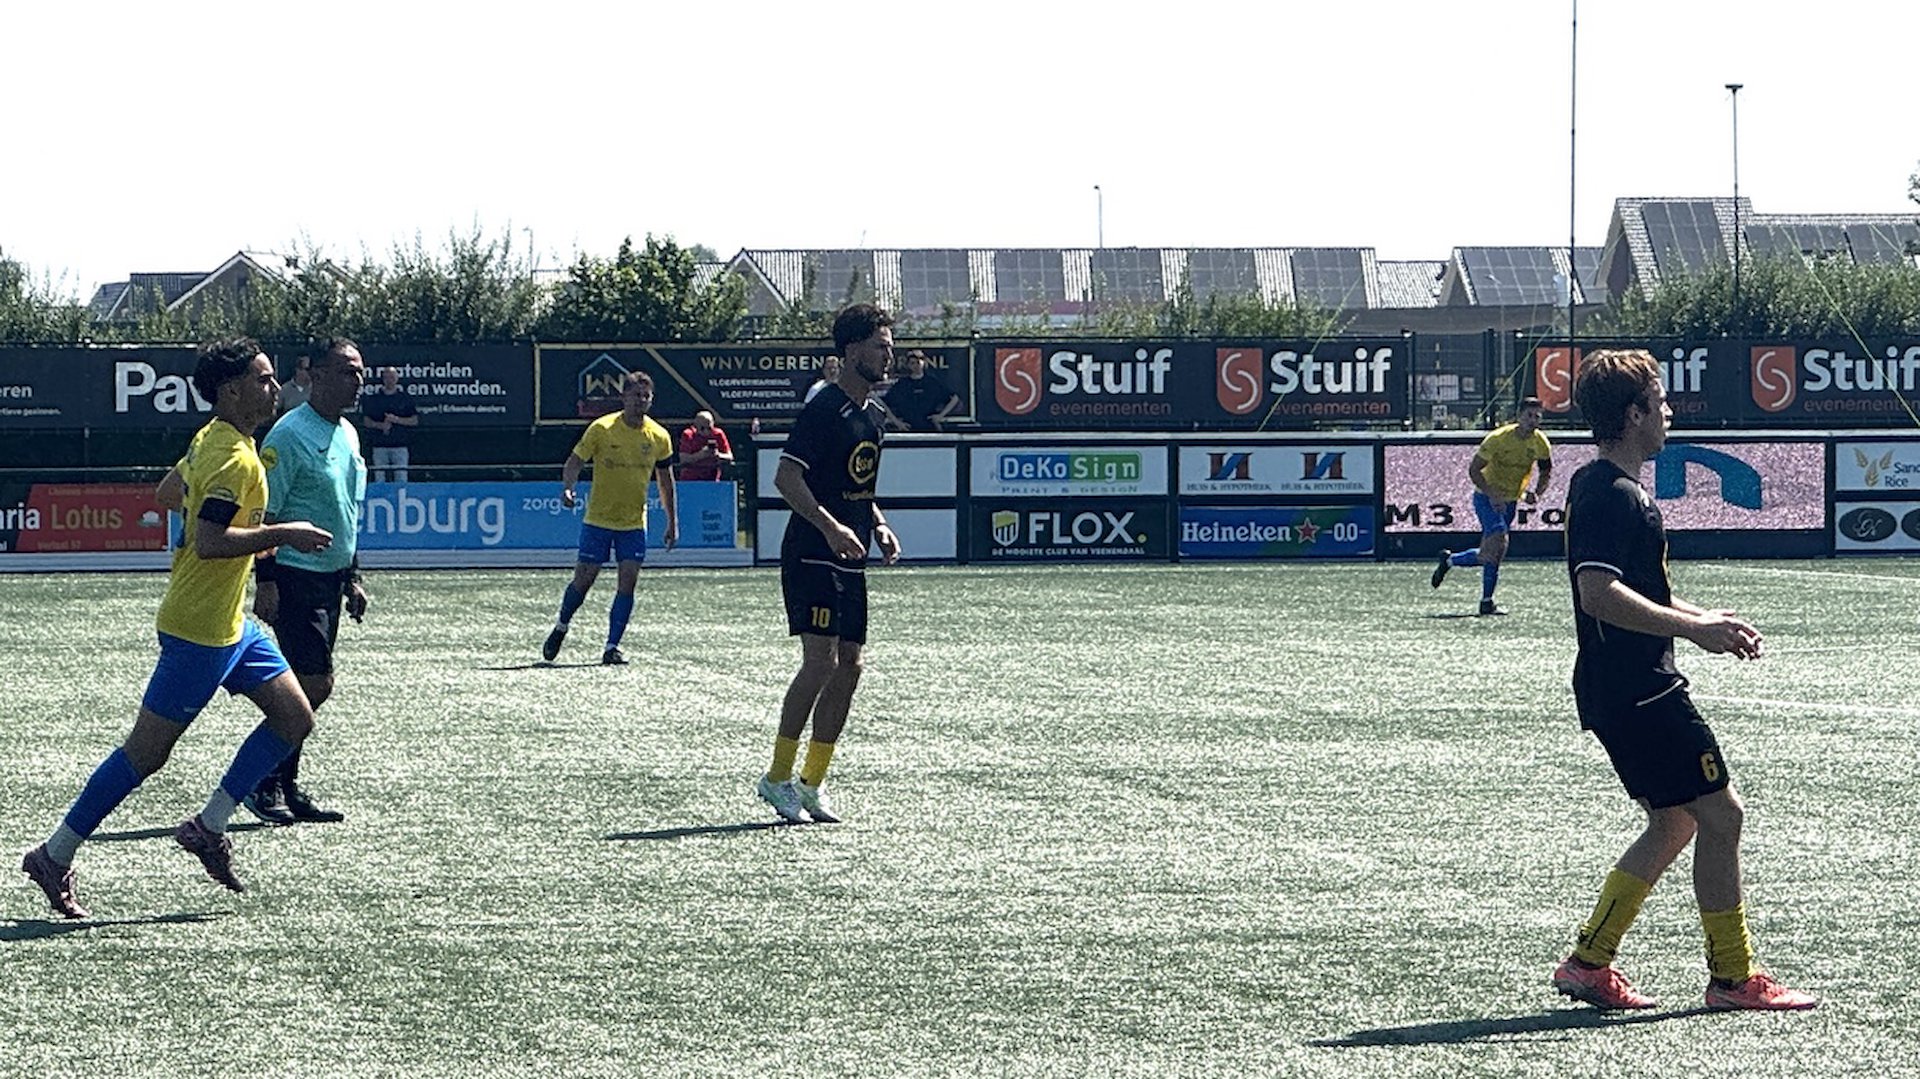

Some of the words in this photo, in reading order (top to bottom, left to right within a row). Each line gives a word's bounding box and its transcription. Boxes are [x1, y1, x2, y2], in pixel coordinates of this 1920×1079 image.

[376, 362, 472, 378] terialen
[1050, 348, 1173, 394] Stuif
[1270, 348, 1392, 394] Stuif
[1802, 346, 1920, 391] Stuif
[407, 383, 429, 396] en
[432, 379, 507, 396] wanden.
[1051, 401, 1171, 416] evenementen
[1273, 401, 1391, 415] evenementen
[1003, 456, 1136, 482] DeKoSign
[1884, 475, 1908, 487] Rice
[0, 502, 40, 530] ria
[52, 504, 122, 530] Lotus
[1517, 508, 1566, 525] ro
[1181, 521, 1292, 542] Heineken
[992, 548, 1003, 556] DE
[1045, 548, 1068, 556] CLUB
[1090, 547, 1145, 555] VEENENDAAL
[811, 606, 831, 629] 10
[1701, 752, 1720, 783] 6
